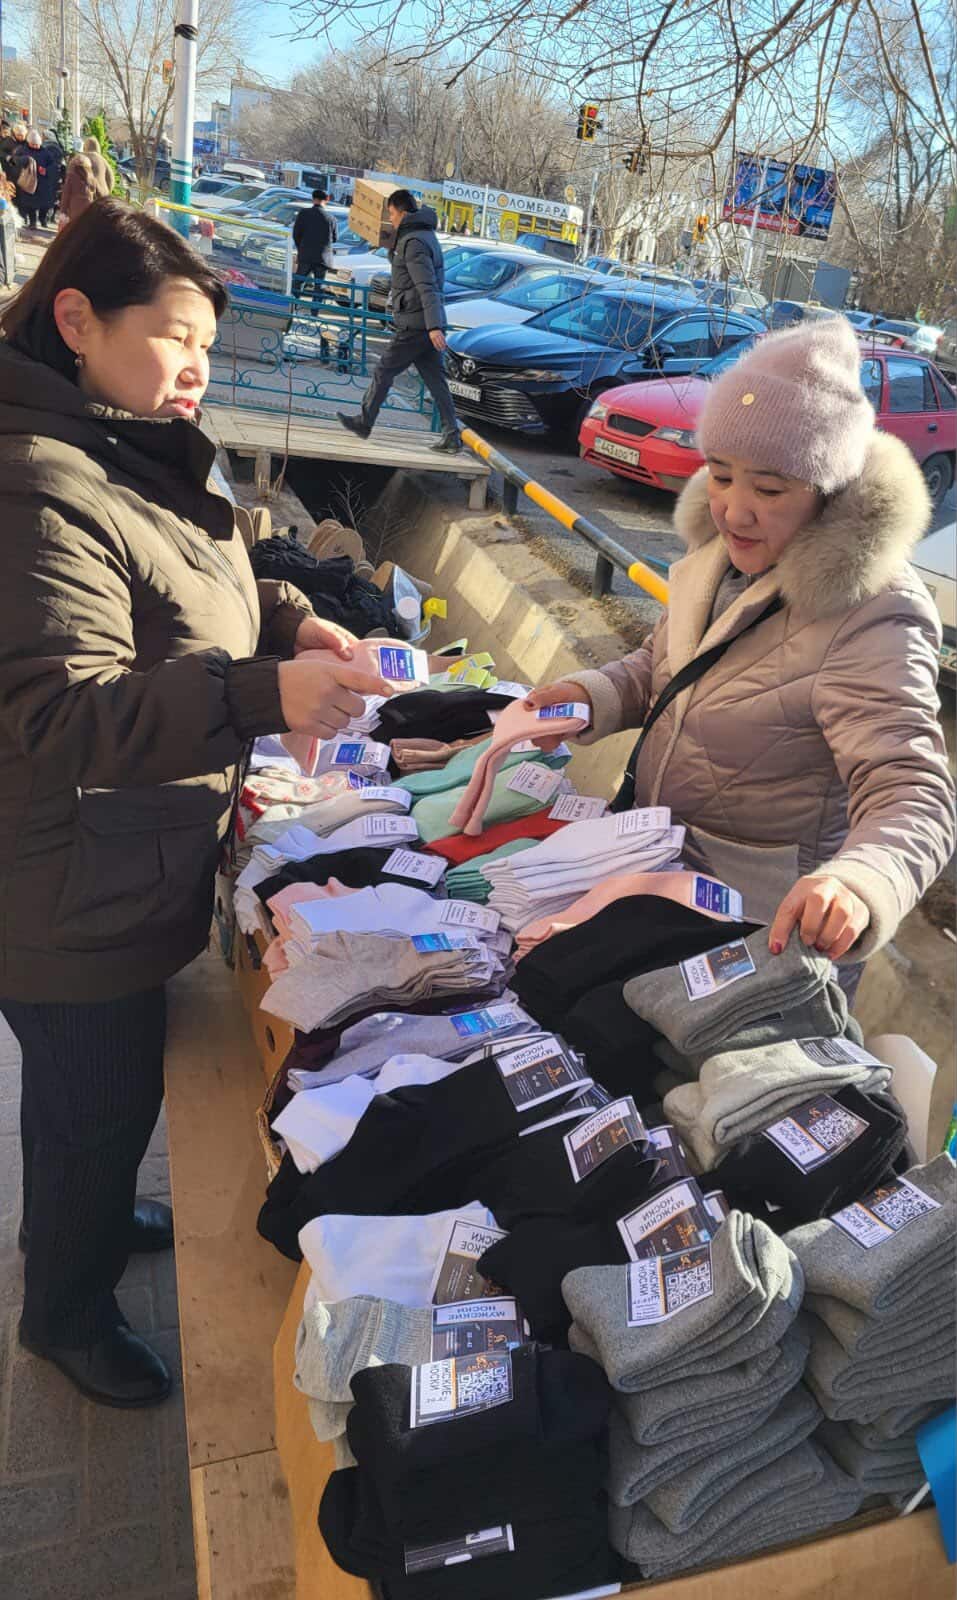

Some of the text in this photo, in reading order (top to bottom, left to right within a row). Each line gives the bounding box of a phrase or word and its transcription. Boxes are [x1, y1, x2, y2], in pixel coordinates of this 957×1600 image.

[509, 198, 569, 218] ЛОМБАРД
[640, 1199, 686, 1234] МУЖСКИЕ
[642, 1195, 674, 1220] НОСКИ
